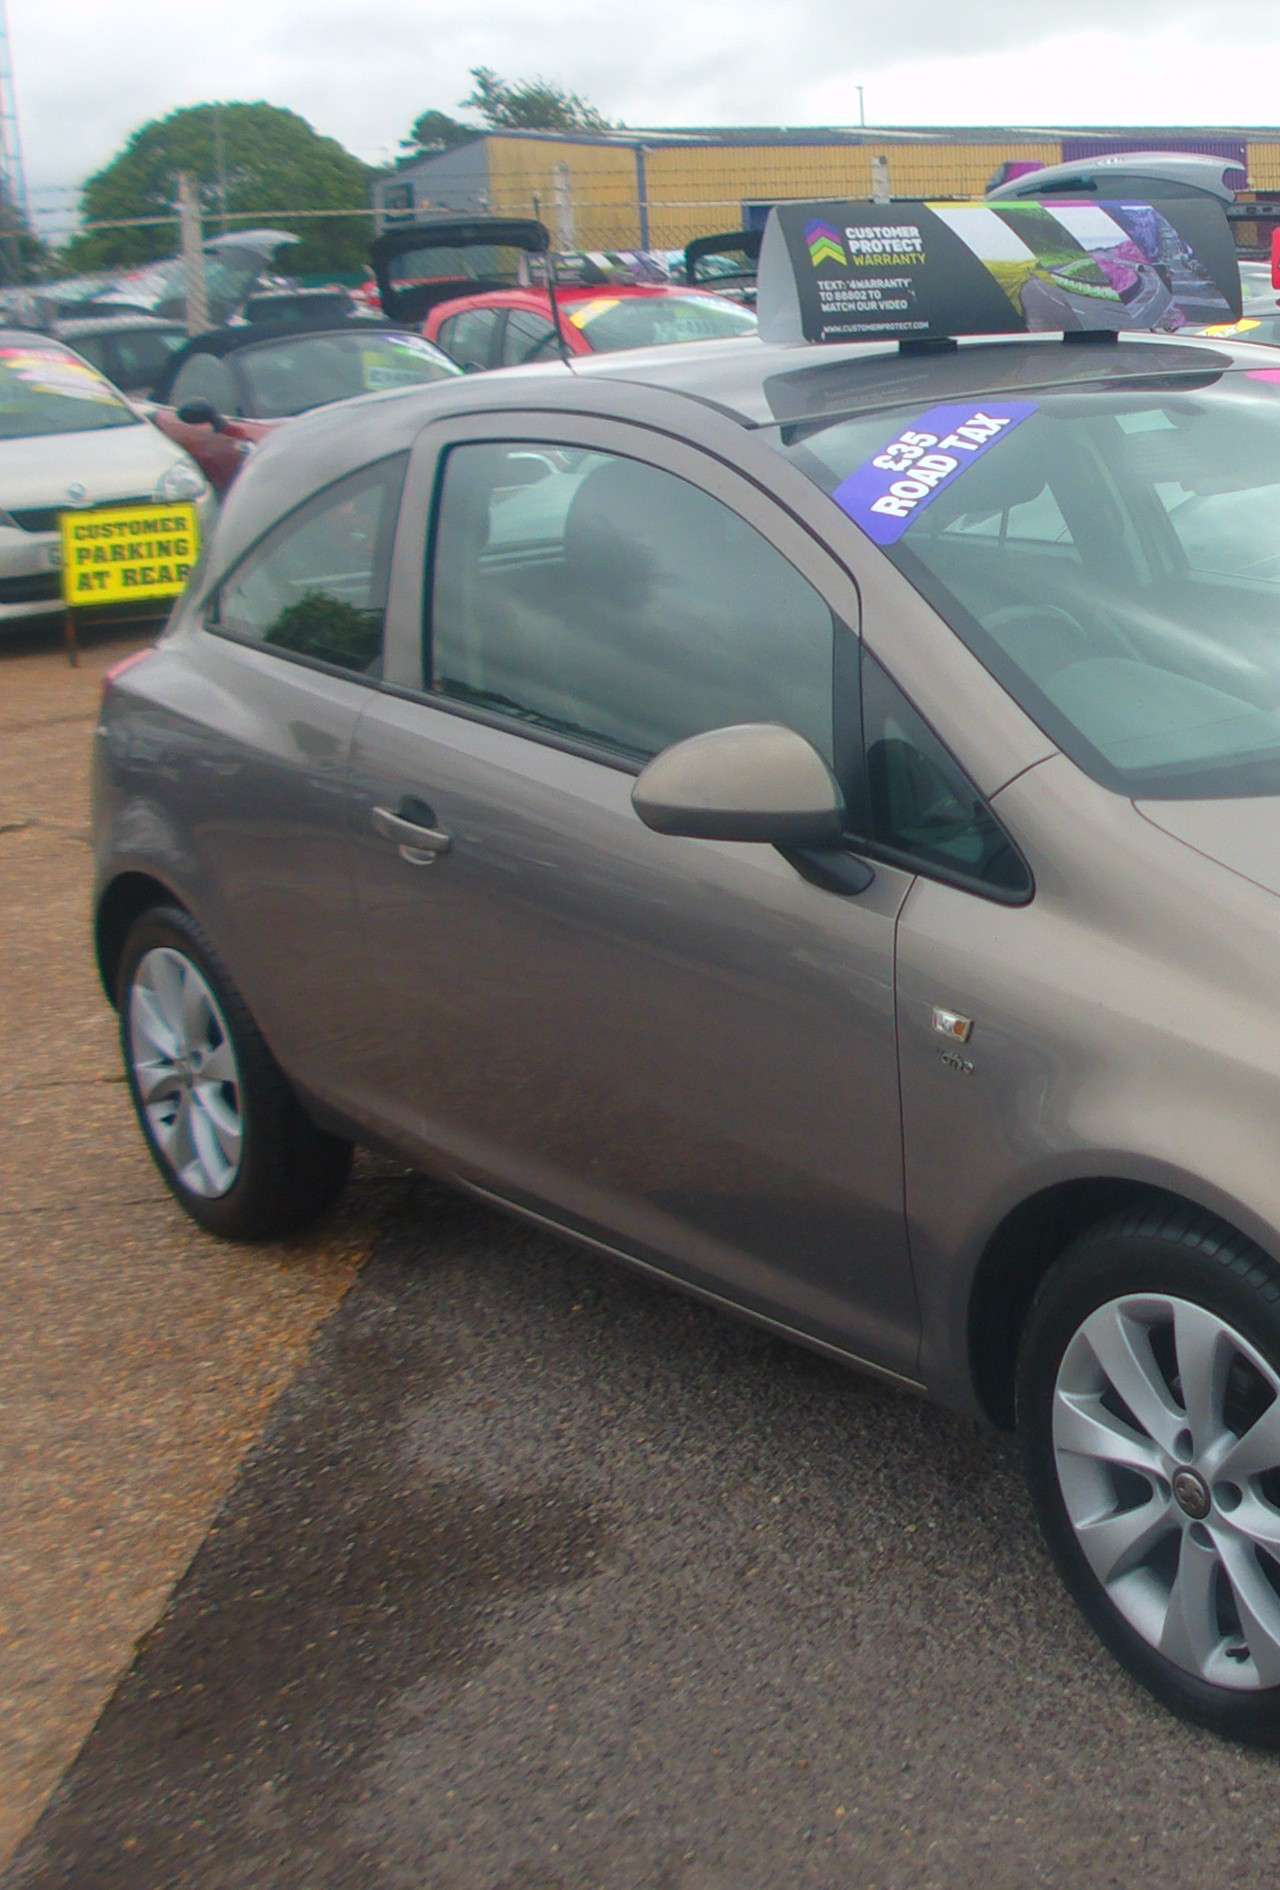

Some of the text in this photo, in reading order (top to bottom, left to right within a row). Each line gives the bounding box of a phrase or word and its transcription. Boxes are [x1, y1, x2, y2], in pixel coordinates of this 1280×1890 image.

[845, 226, 920, 239] CUSTOMER
[848, 239, 922, 253] PROTECT
[852, 253, 926, 266] WARRANTY
[820, 291, 833, 302] TO
[869, 289, 882, 300] TO
[821, 299, 909, 313] WATCH OUR VIDEO
[872, 431, 939, 472] £35
[870, 412, 1011, 518] ROAD TAX
[74, 516, 187, 541] CUSTOMER
[76, 539, 189, 566] PARKING
[76, 563, 191, 591] AT REAR
